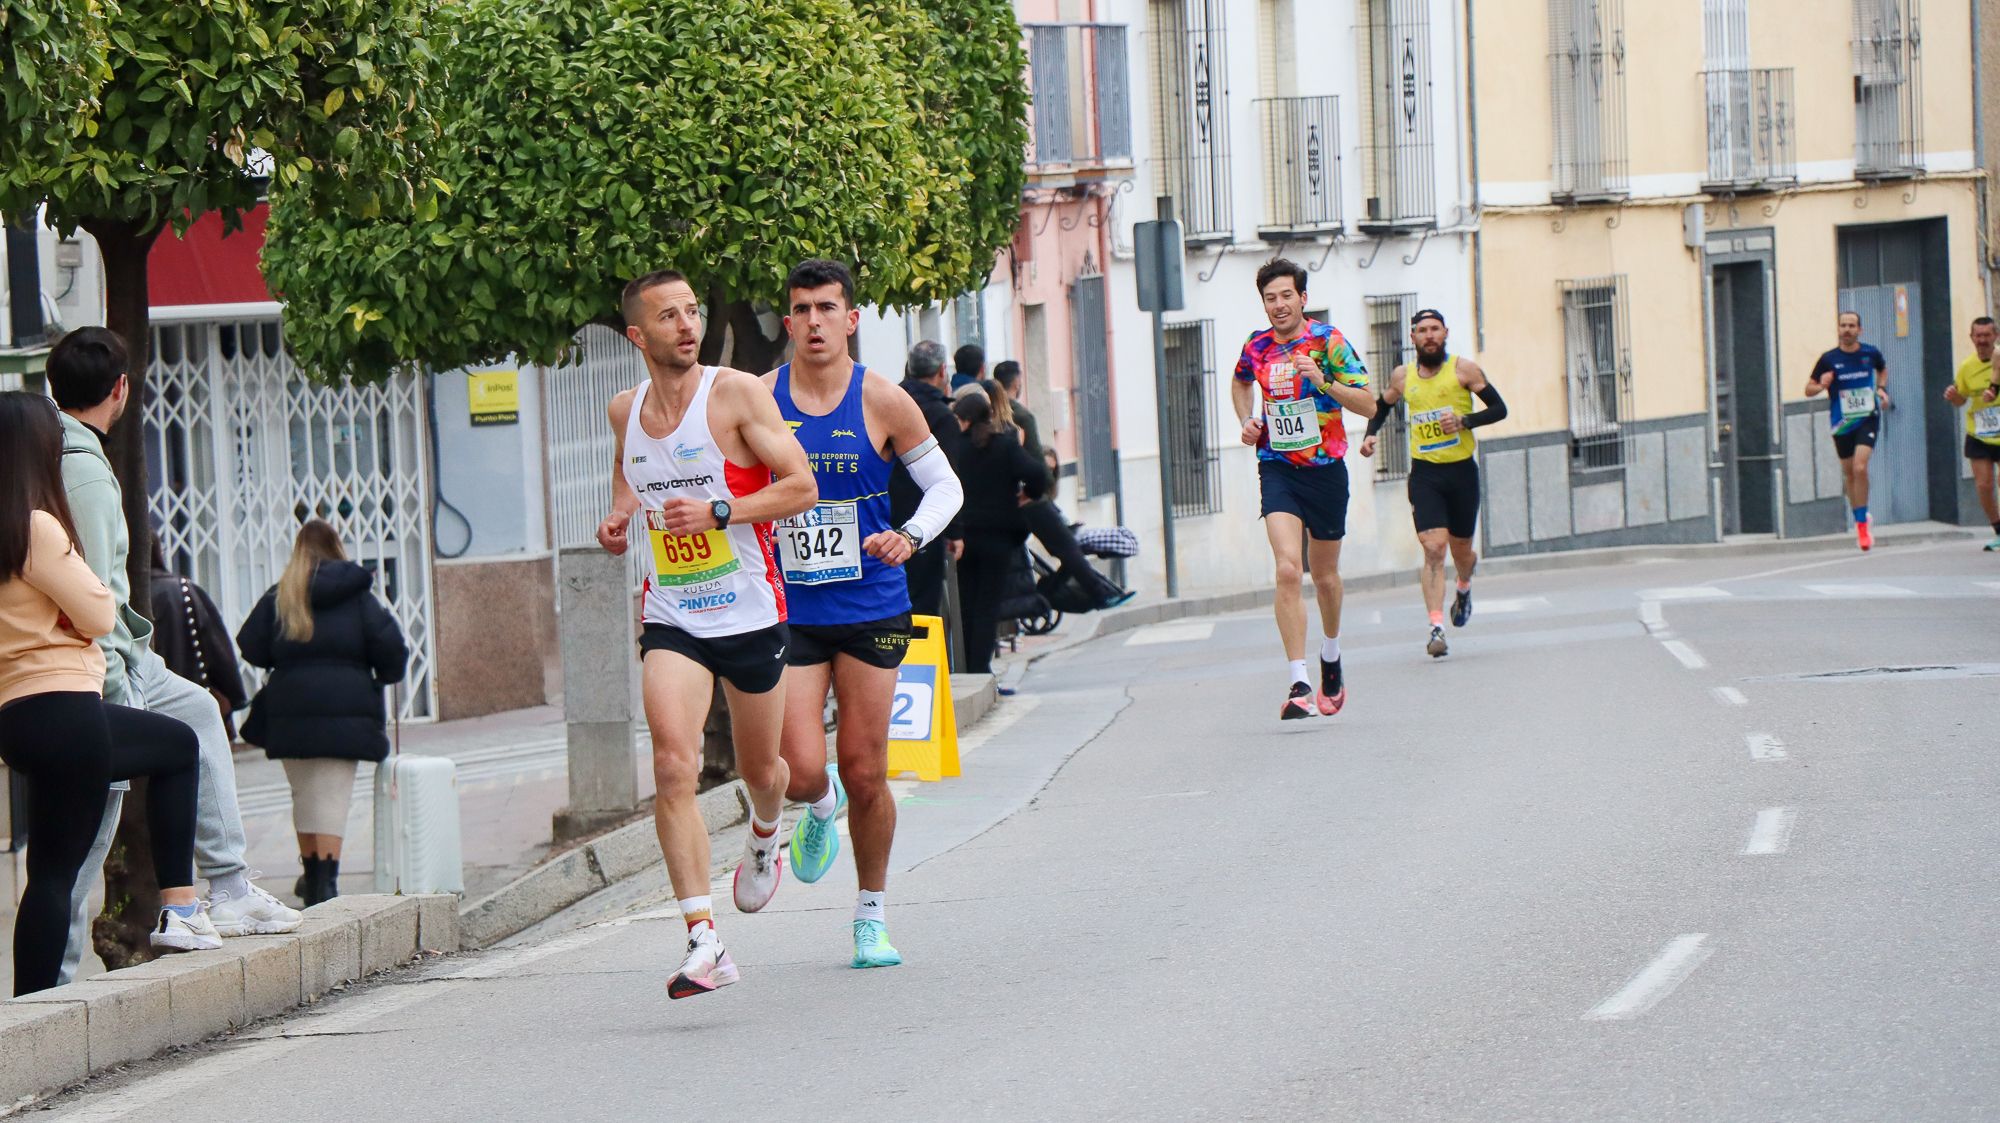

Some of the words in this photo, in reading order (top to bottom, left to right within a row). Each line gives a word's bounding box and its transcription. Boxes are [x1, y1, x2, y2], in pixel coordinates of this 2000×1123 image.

[487, 383, 513, 392] InPost
[1275, 416, 1304, 436] 904
[1418, 422, 1446, 439] 126
[821, 453, 860, 461] DEPORTIVO
[809, 461, 858, 473] NTES
[662, 531, 712, 563] 659
[788, 527, 844, 561] 1342
[678, 591, 737, 610] PINVECO
[890, 692, 914, 726] 2
